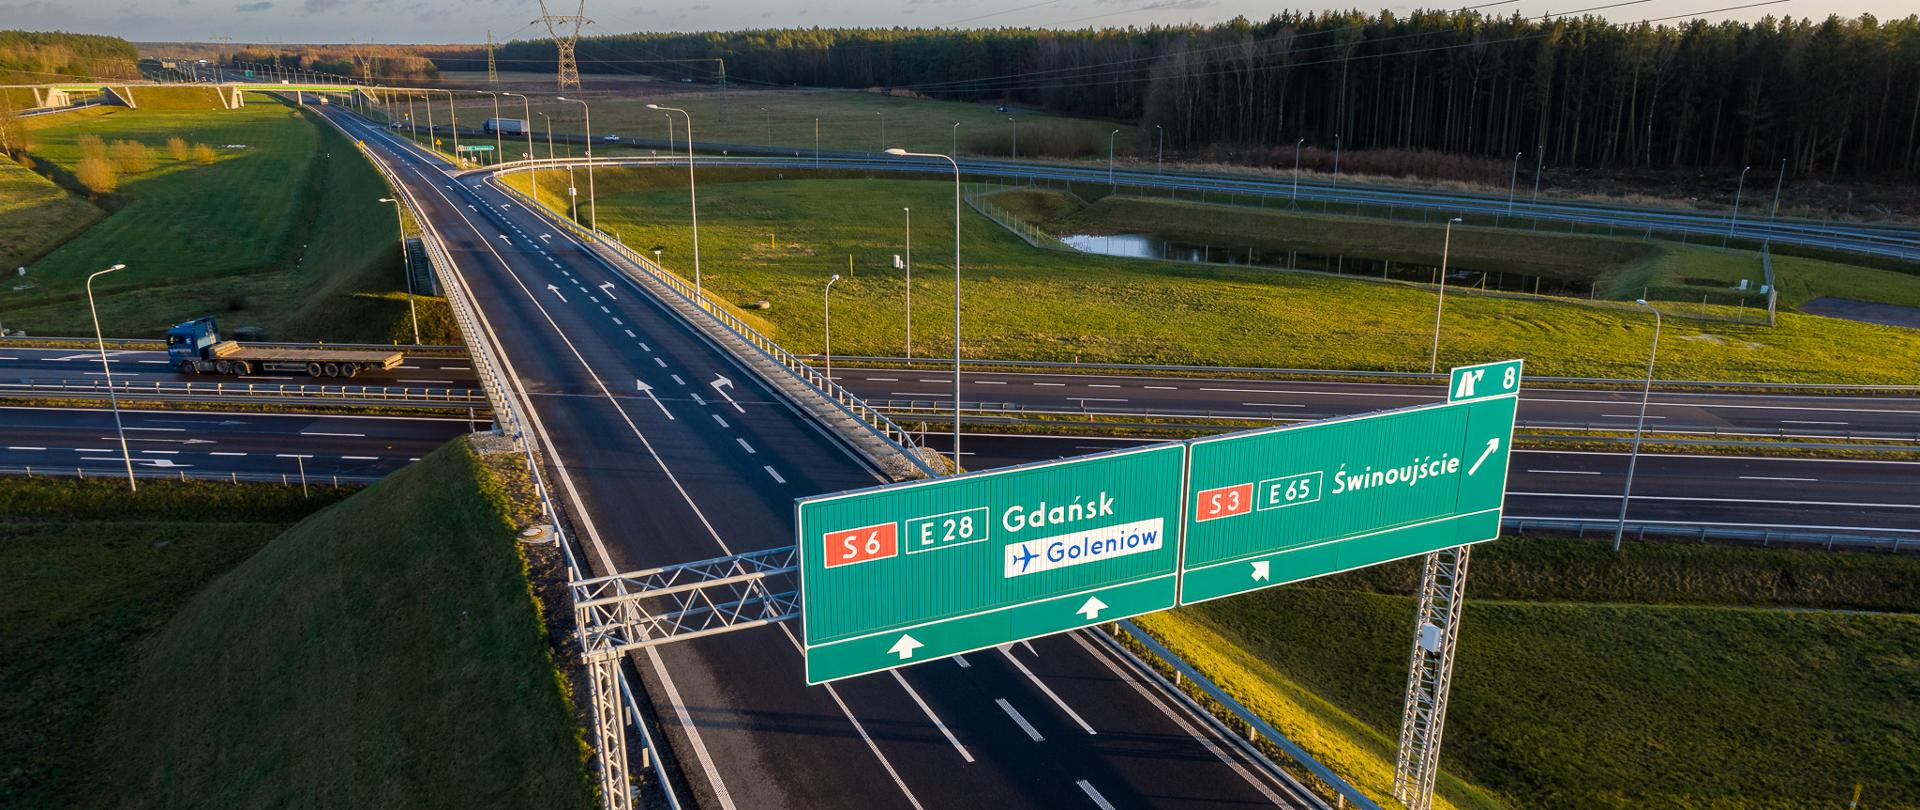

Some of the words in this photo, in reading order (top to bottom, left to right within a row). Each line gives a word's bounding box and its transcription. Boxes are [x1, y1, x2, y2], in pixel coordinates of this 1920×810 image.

[1503, 366, 1516, 390] 8
[1332, 454, 1460, 494] Świnoujście
[1209, 494, 1222, 515] S
[1227, 490, 1240, 511] 3
[1269, 484, 1281, 505] E
[1284, 479, 1311, 502] 65
[1002, 492, 1115, 533] Gdańsk
[842, 535, 857, 559] S
[864, 530, 882, 553] 6
[920, 522, 935, 546] E
[942, 516, 974, 541] 28
[1046, 529, 1158, 562] Goleniów
